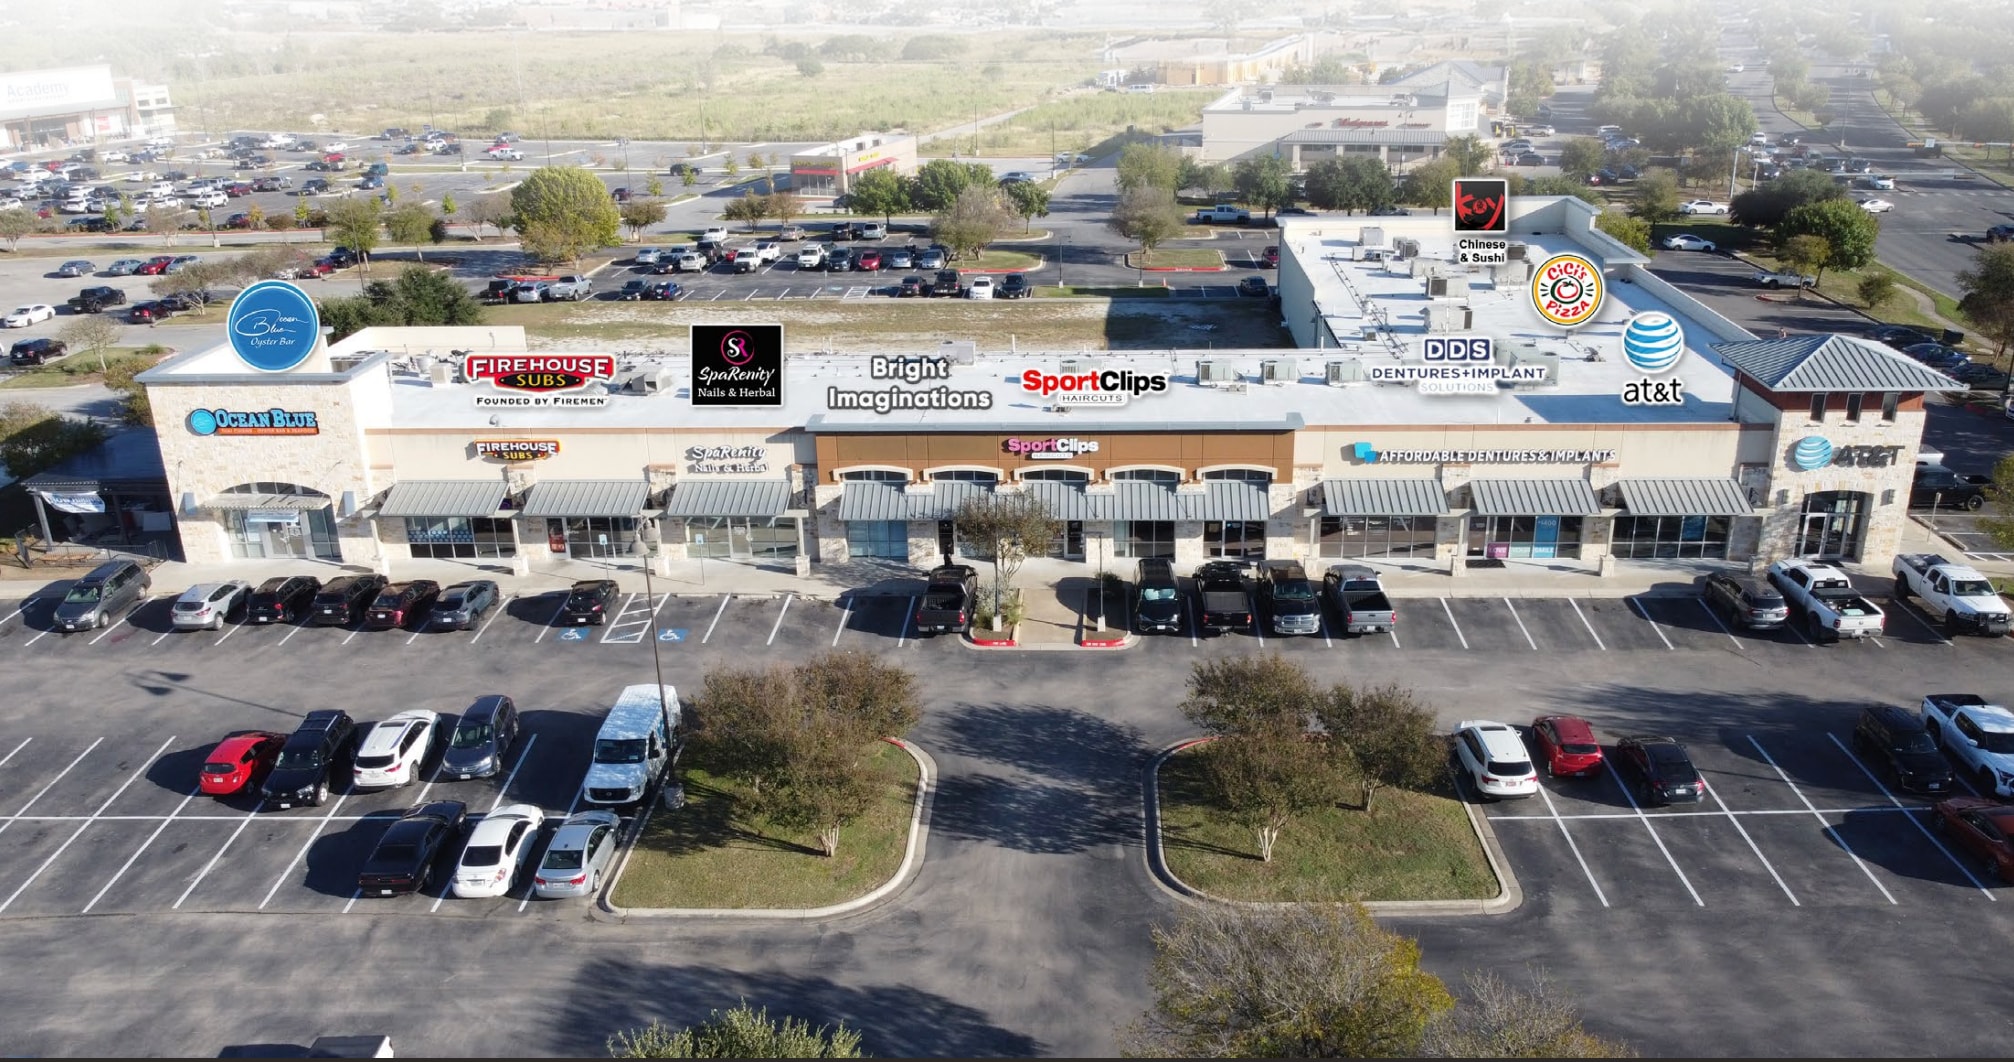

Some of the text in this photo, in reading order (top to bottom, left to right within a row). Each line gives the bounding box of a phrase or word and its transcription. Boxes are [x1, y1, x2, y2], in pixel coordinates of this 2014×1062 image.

[7, 82, 70, 98] Academy
[214, 409, 317, 427] OCEAN BLUE
[476, 442, 558, 456] FIREHOUSE
[692, 445, 767, 461] SpaRenity
[1008, 438, 1099, 454] SportClips
[502, 451, 533, 459] SUBS
[1380, 450, 1465, 461] AFFORDABLE
[694, 463, 769, 473] Nails & Herbal
